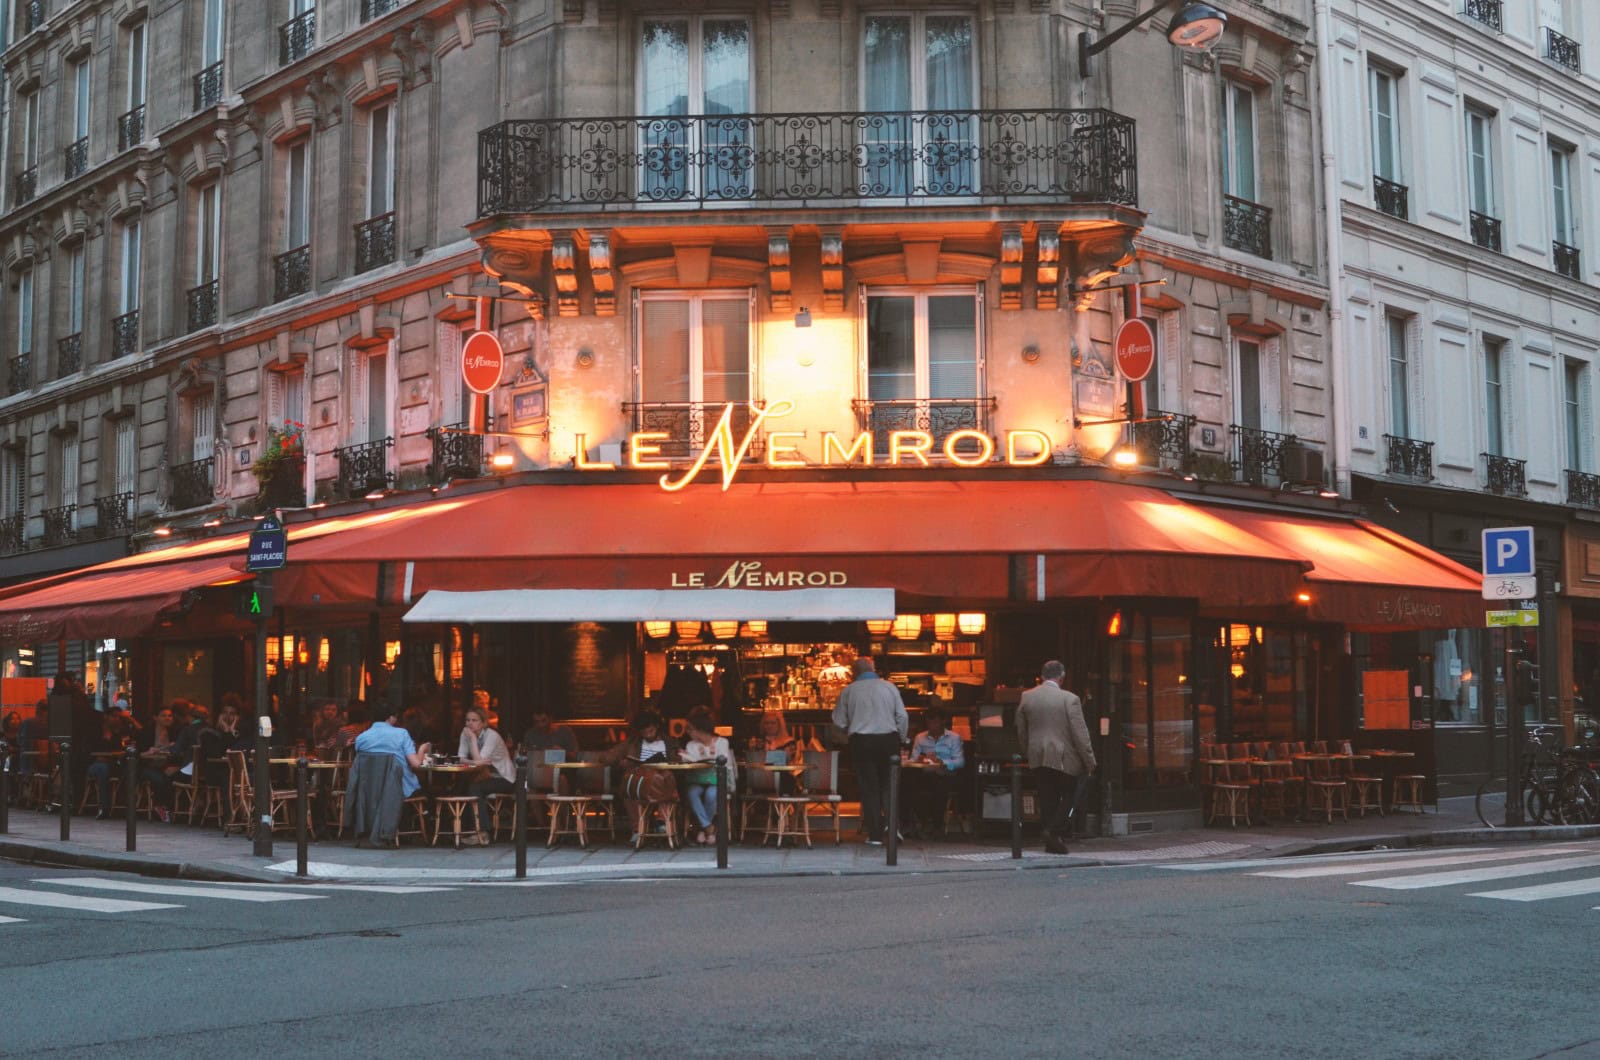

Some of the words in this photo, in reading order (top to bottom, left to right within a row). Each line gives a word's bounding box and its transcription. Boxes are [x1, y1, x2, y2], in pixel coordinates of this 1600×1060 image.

[465, 357, 474, 366] LE
[574, 431, 672, 470] LE
[658, 399, 1053, 491] NEMROD
[261, 541, 273, 549] RUE
[1496, 538, 1518, 567] P
[250, 552, 283, 561] SAINT-PLACIDE
[671, 572, 705, 587] LE
[702, 560, 848, 588] NEMROD
